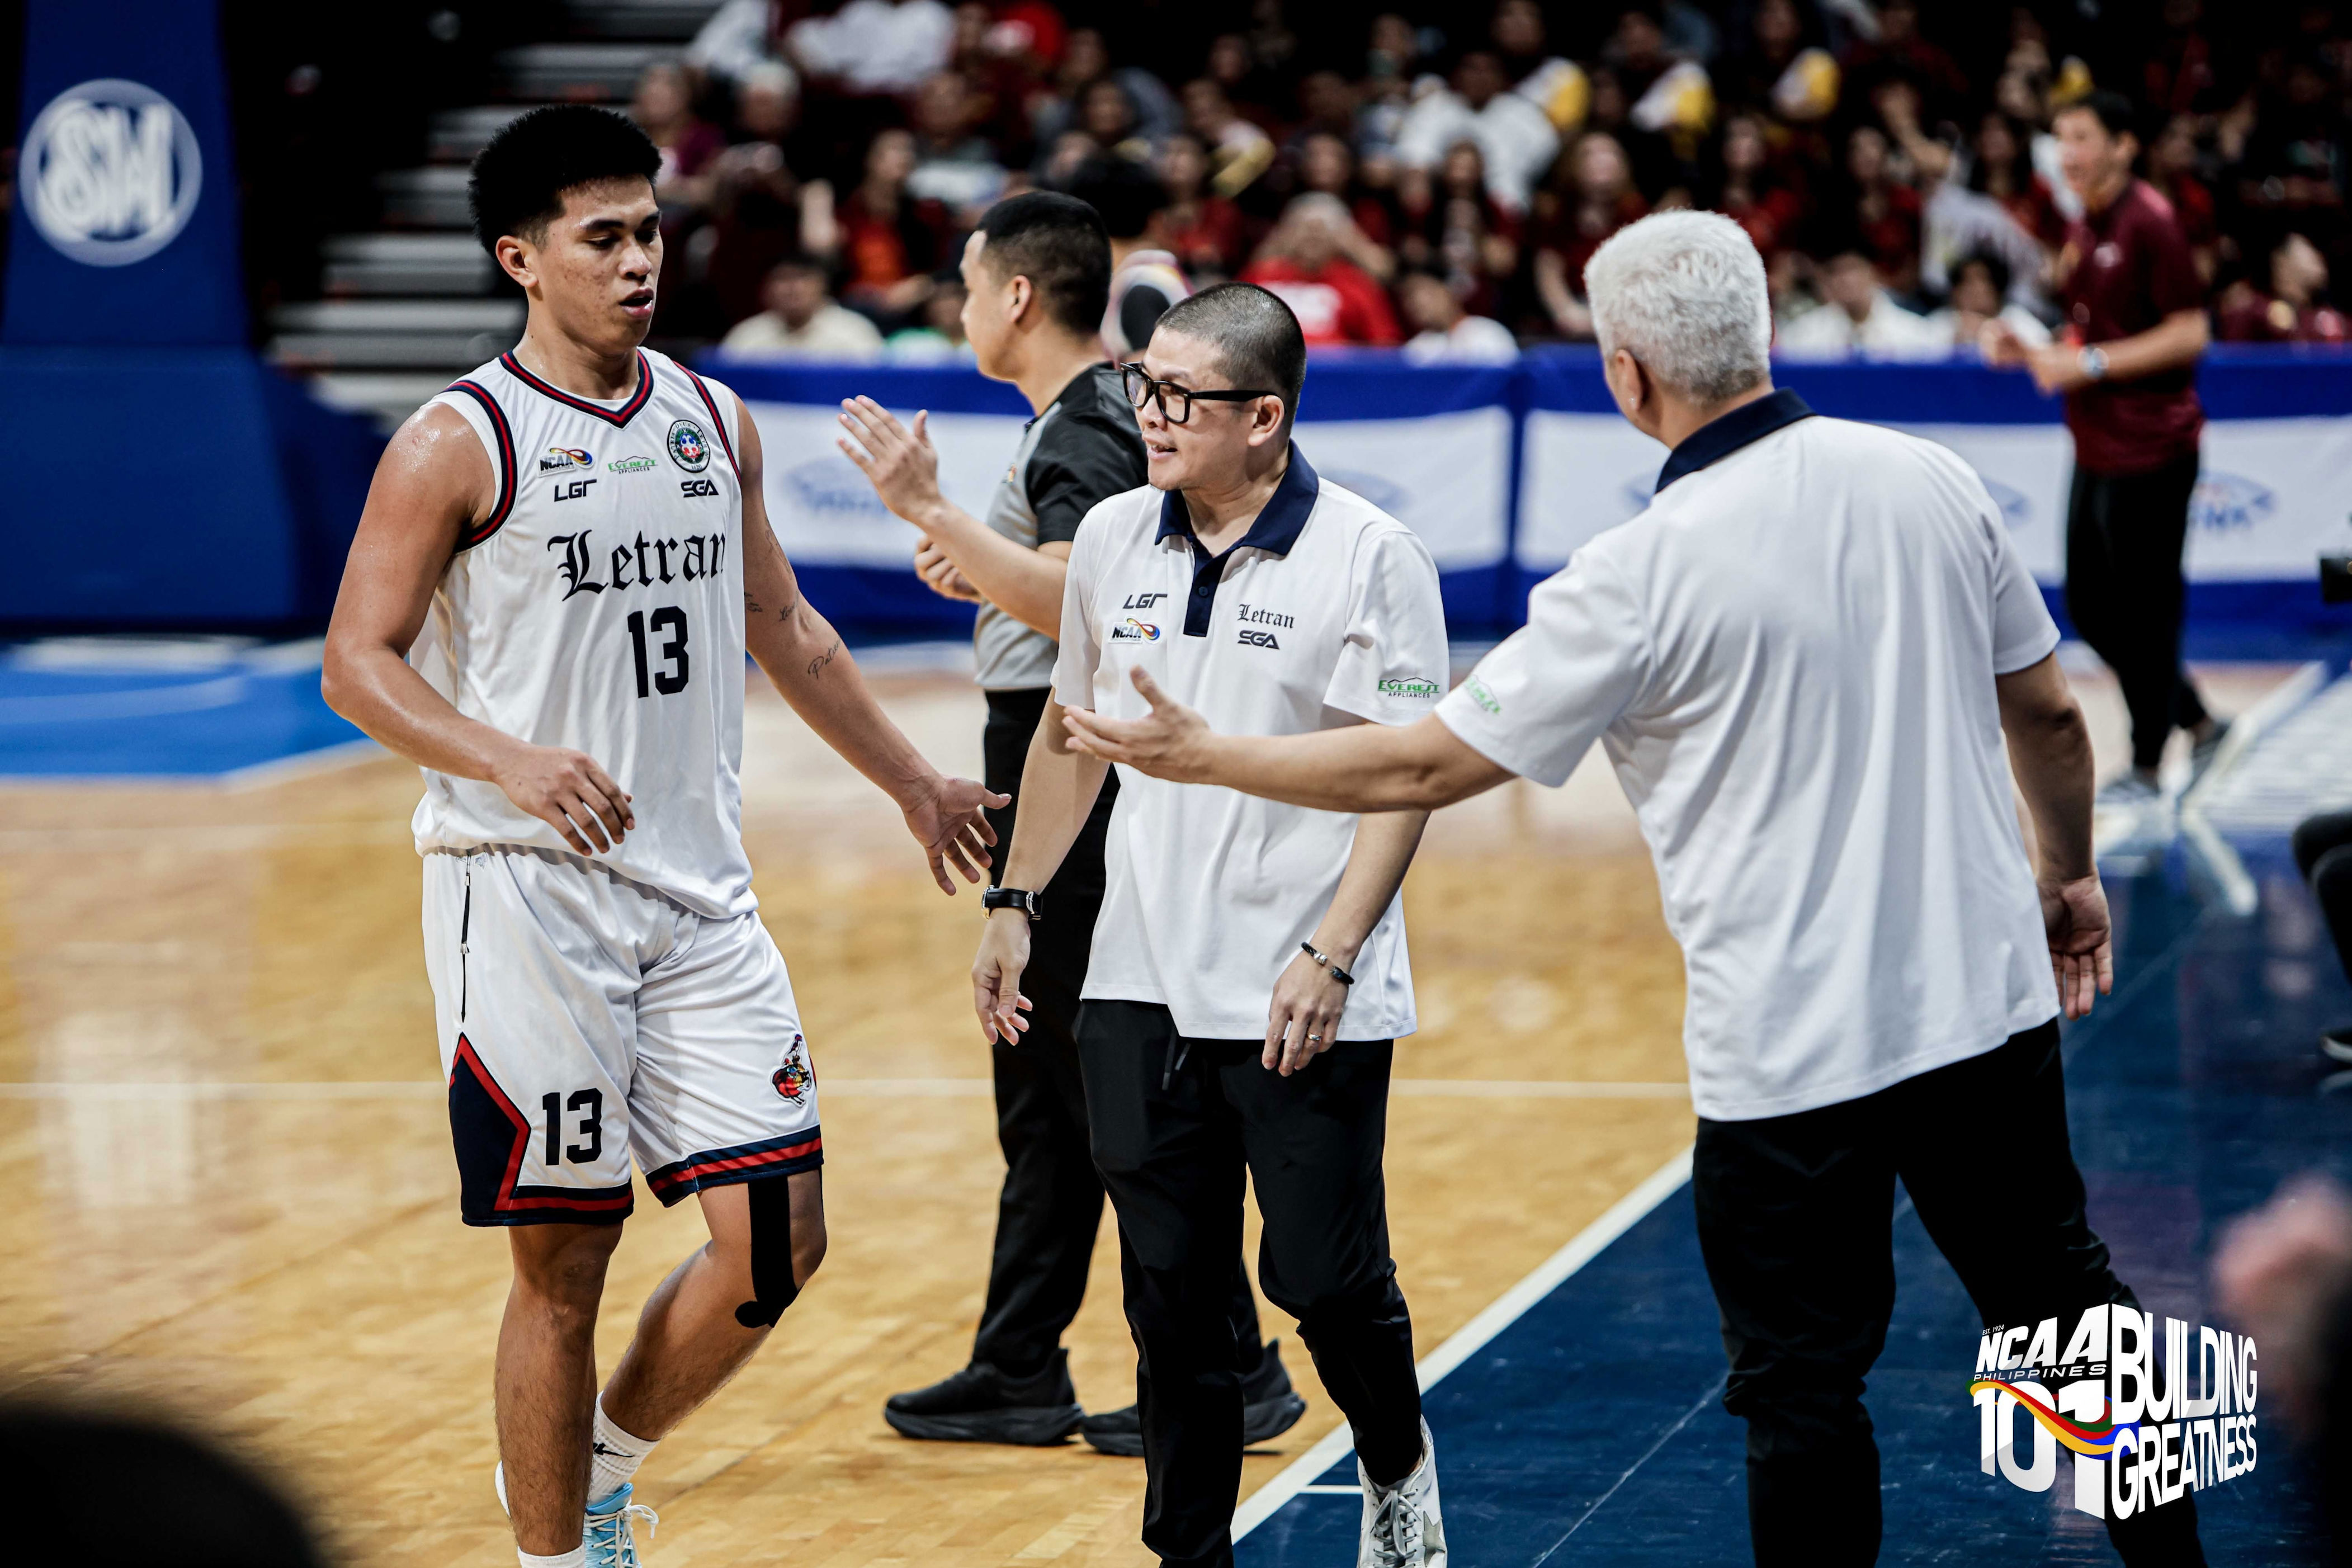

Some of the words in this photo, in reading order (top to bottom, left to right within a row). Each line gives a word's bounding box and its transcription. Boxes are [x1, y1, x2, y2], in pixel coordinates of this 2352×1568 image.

[540, 454, 573, 471] NCAA
[608, 459, 657, 471] EVEREST
[681, 479, 719, 498] SGA
[547, 530, 726, 602] Letran
[1237, 603, 1295, 629] Letran
[1112, 626, 1141, 638] NCAA
[1237, 630, 1280, 650] SGA
[627, 606, 689, 698] 13
[1378, 680, 1440, 692] EVEREST
[542, 1088, 603, 1166] 13
